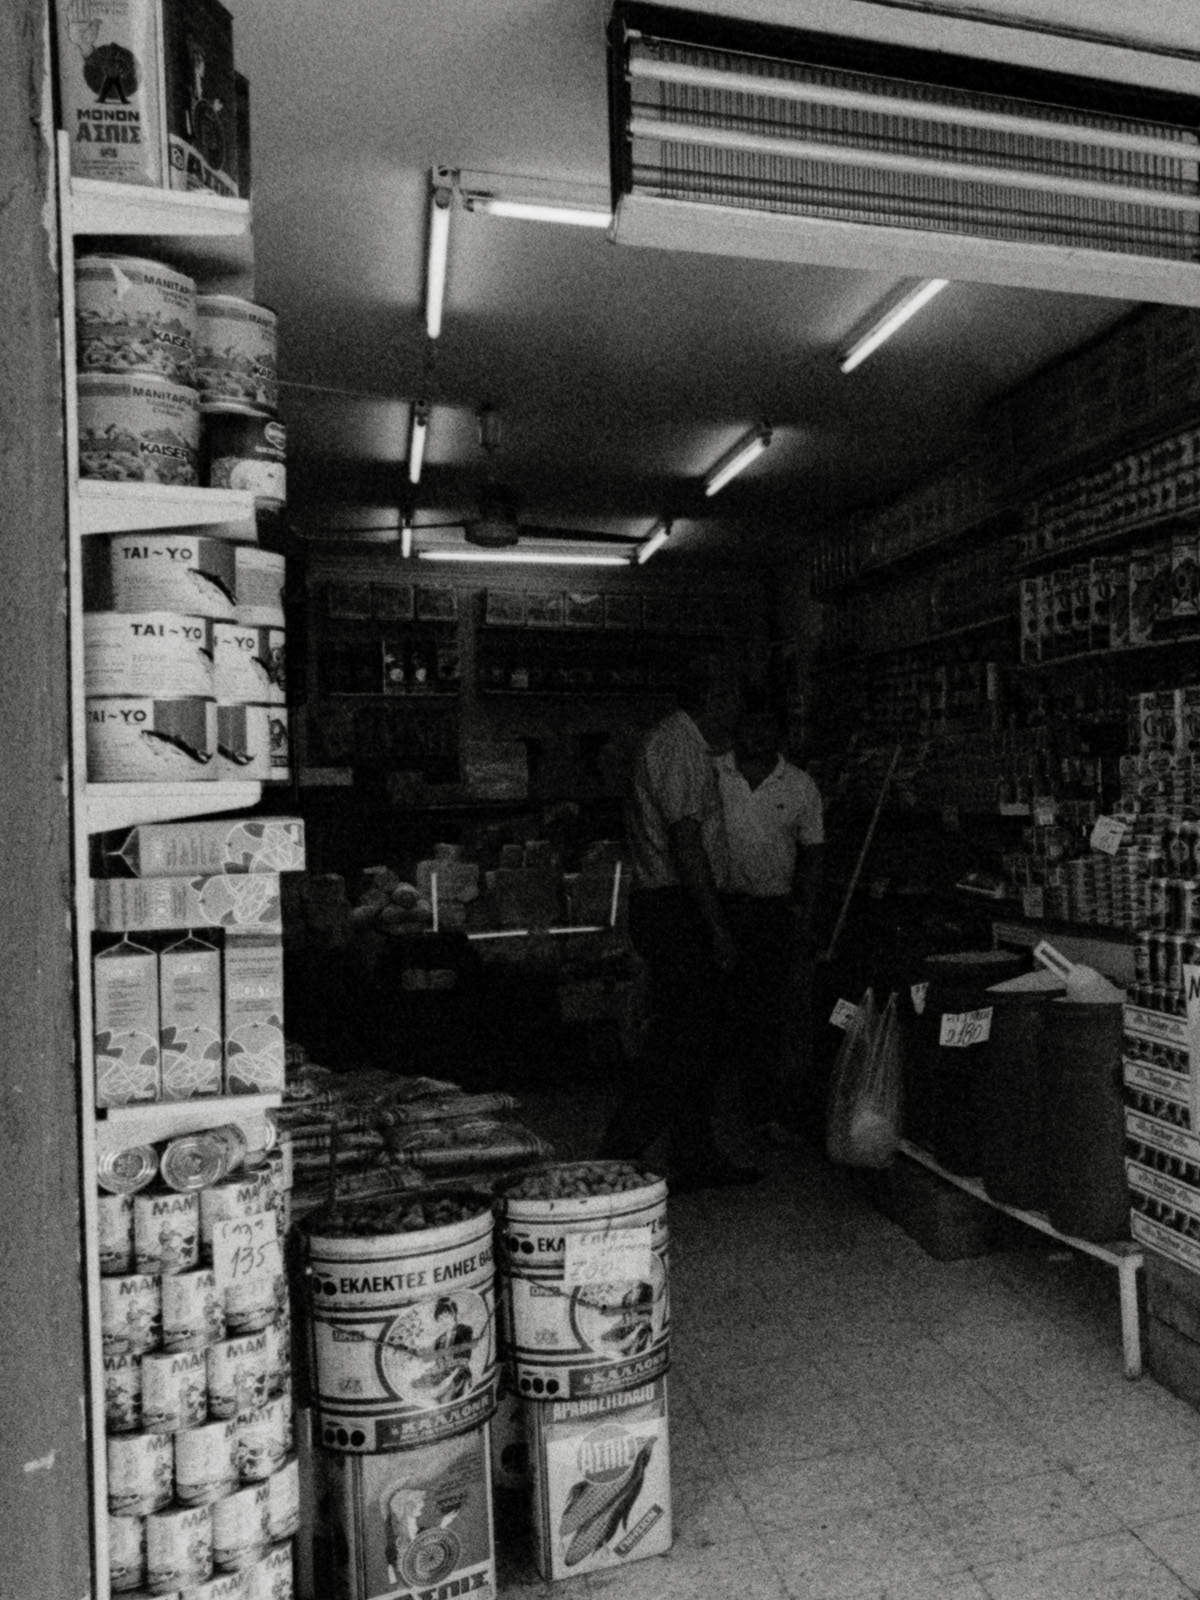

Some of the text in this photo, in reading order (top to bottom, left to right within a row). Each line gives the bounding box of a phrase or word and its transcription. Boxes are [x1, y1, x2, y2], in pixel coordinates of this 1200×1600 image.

[76, 108, 140, 122] ΜΟΝΟΝ
[75, 122, 142, 144] ΑΣΠΙΣ
[152, 330, 193, 350] KAISE
[340, 1256, 478, 1294] ΕΚΛΕΚΤΕΣ ΕΛΗΕΣ
[393, 1570, 490, 1600] ΣΠΙΣ
